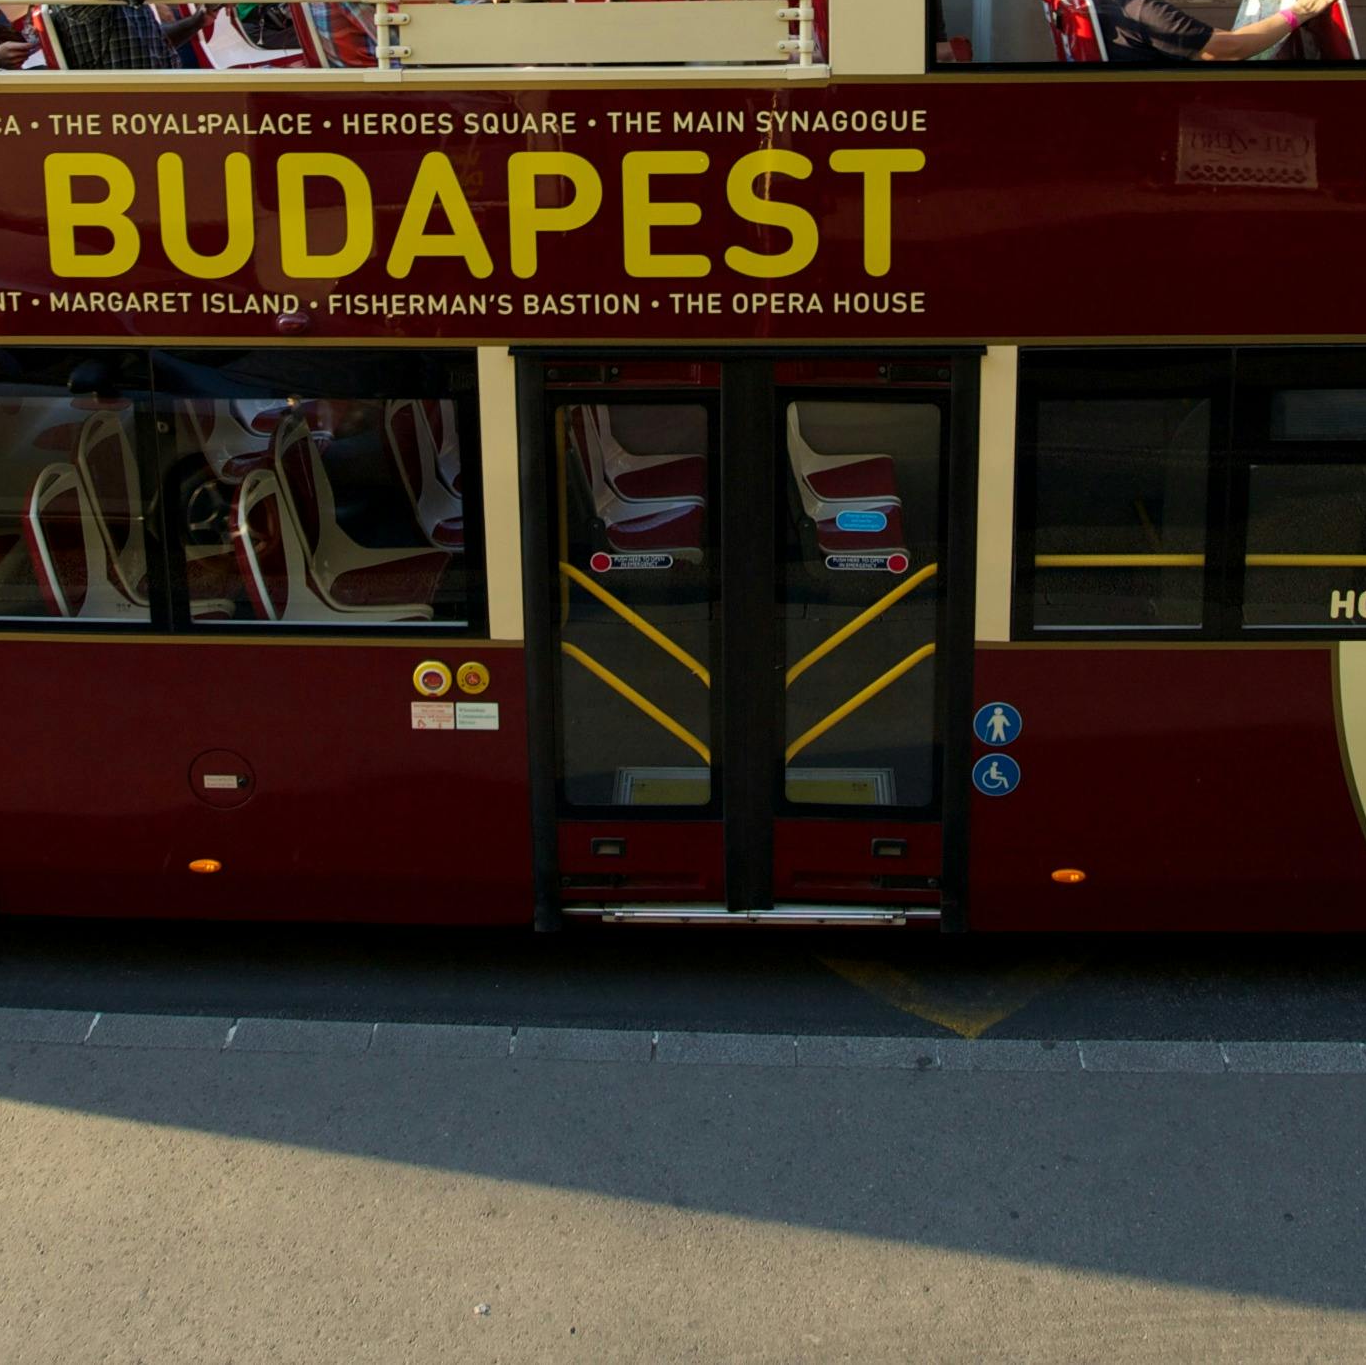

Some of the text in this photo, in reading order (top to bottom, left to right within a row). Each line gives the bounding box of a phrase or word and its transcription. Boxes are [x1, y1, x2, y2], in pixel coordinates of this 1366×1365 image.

[47, 113, 102, 136] THE
[342, 112, 454, 135] HEROES
[463, 112, 577, 135] SQUARE
[606, 111, 662, 133] THE
[673, 110, 744, 133] MAIN
[756, 109, 927, 133] SYNAGOGUE
[44, 148, 927, 279] BUDAPEST
[49, 291, 193, 313] MARGARET
[202, 292, 300, 314] ISLAND
[328, 292, 513, 315] FISHERMAN'S
[523, 293, 640, 315] BASTION
[669, 293, 722, 314] THE
[732, 292, 824, 314] OPERA
[833, 291, 926, 314] HOUSE
